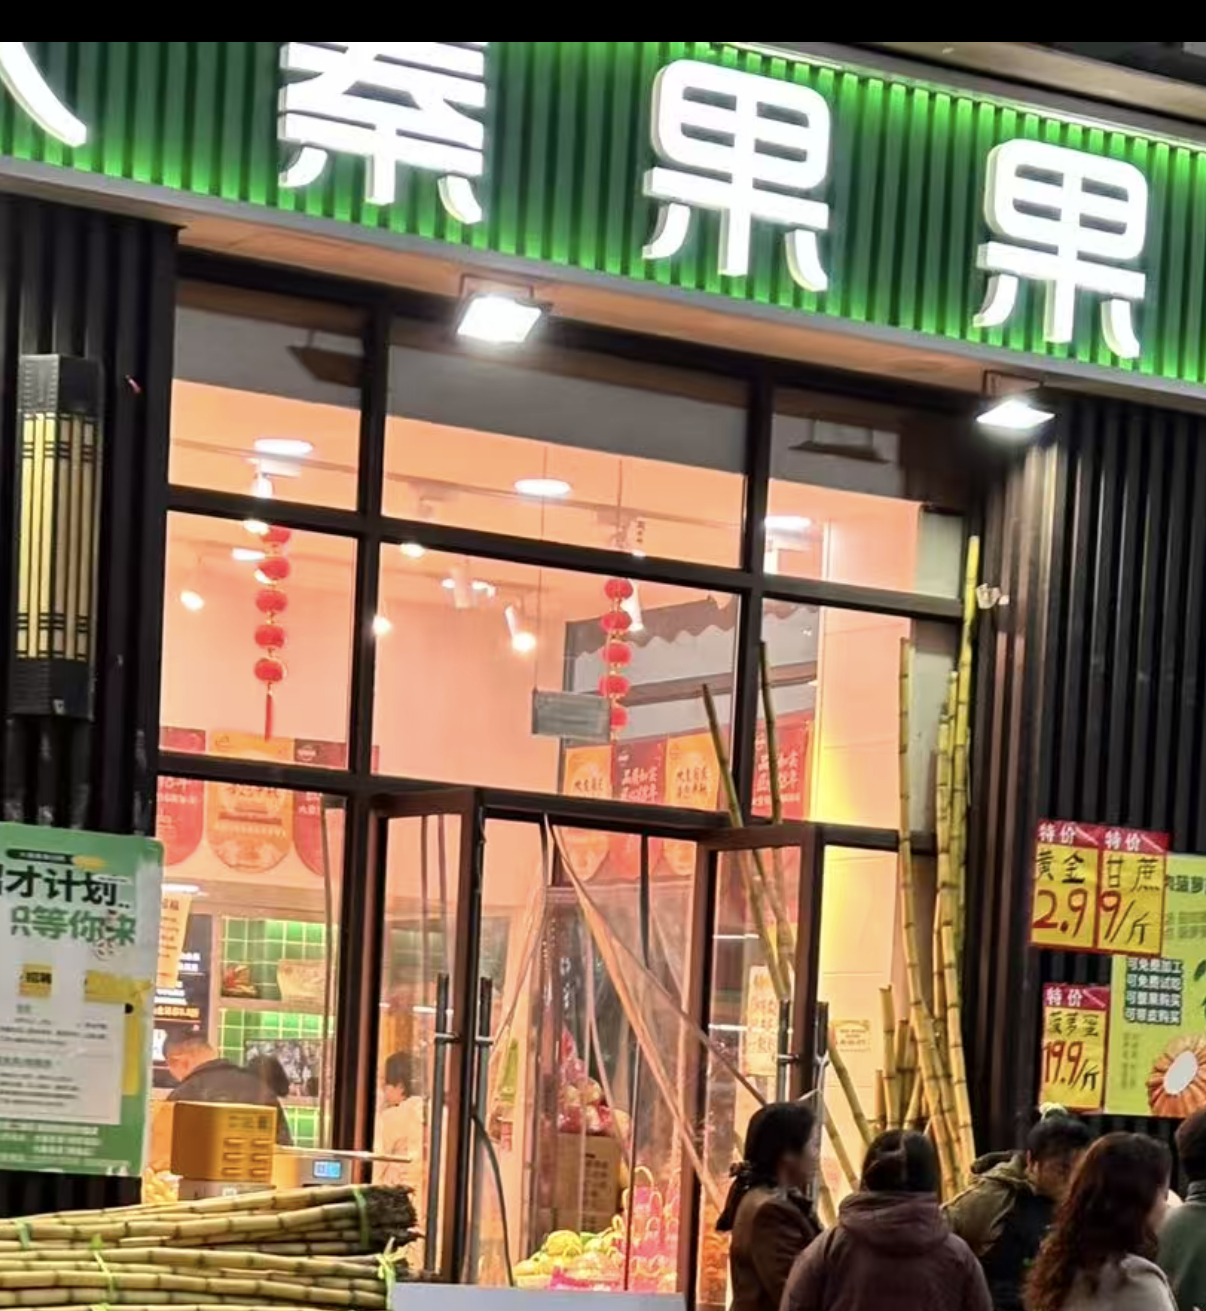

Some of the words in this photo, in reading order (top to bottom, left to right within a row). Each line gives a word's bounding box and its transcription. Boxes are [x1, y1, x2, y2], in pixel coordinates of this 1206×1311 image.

[1038, 822, 1077, 845] 特价
[1105, 830, 1142, 852] 特价
[1105, 855, 1161, 893] 甘蔗
[11, 904, 136, 946] 只等你来
[1033, 888, 1089, 938] 2.9
[1045, 986, 1084, 1007] 特价
